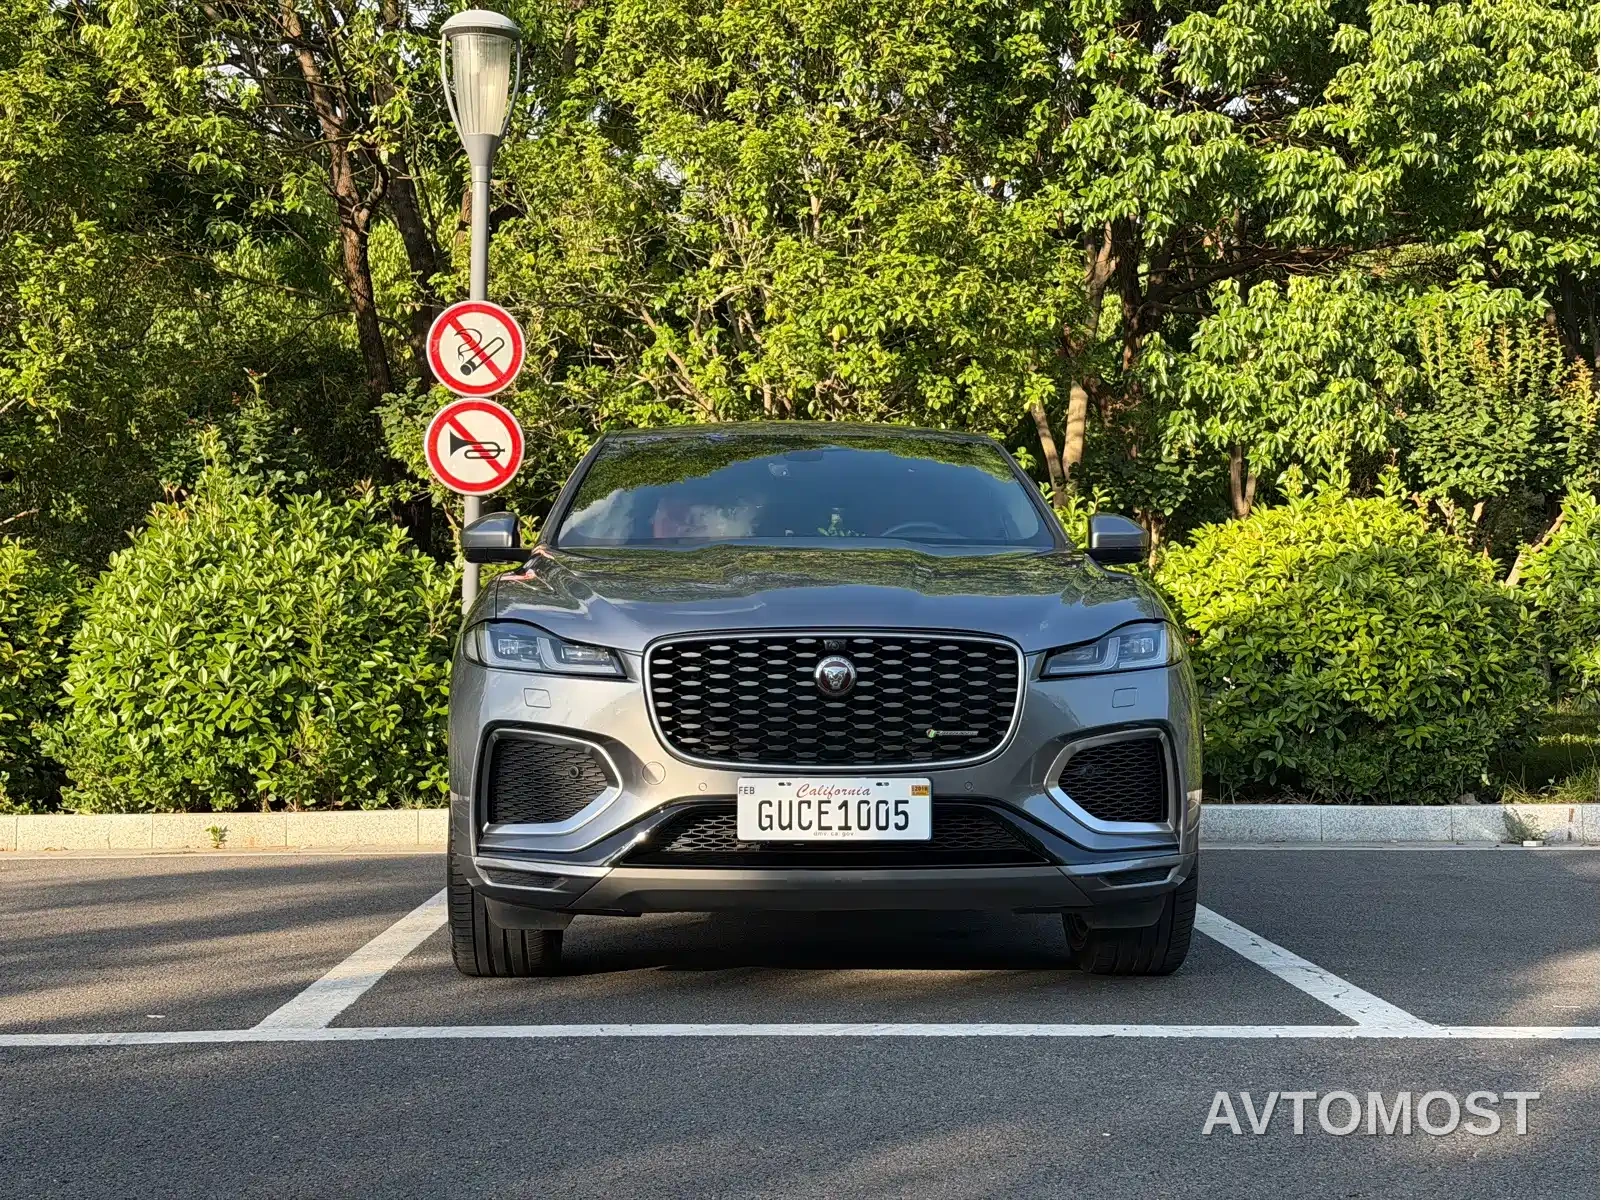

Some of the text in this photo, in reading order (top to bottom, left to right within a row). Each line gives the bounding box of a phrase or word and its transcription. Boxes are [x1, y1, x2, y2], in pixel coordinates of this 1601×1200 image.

[738, 786, 755, 794] FEB
[796, 783, 871, 800] California
[758, 800, 910, 831] GUCE1005
